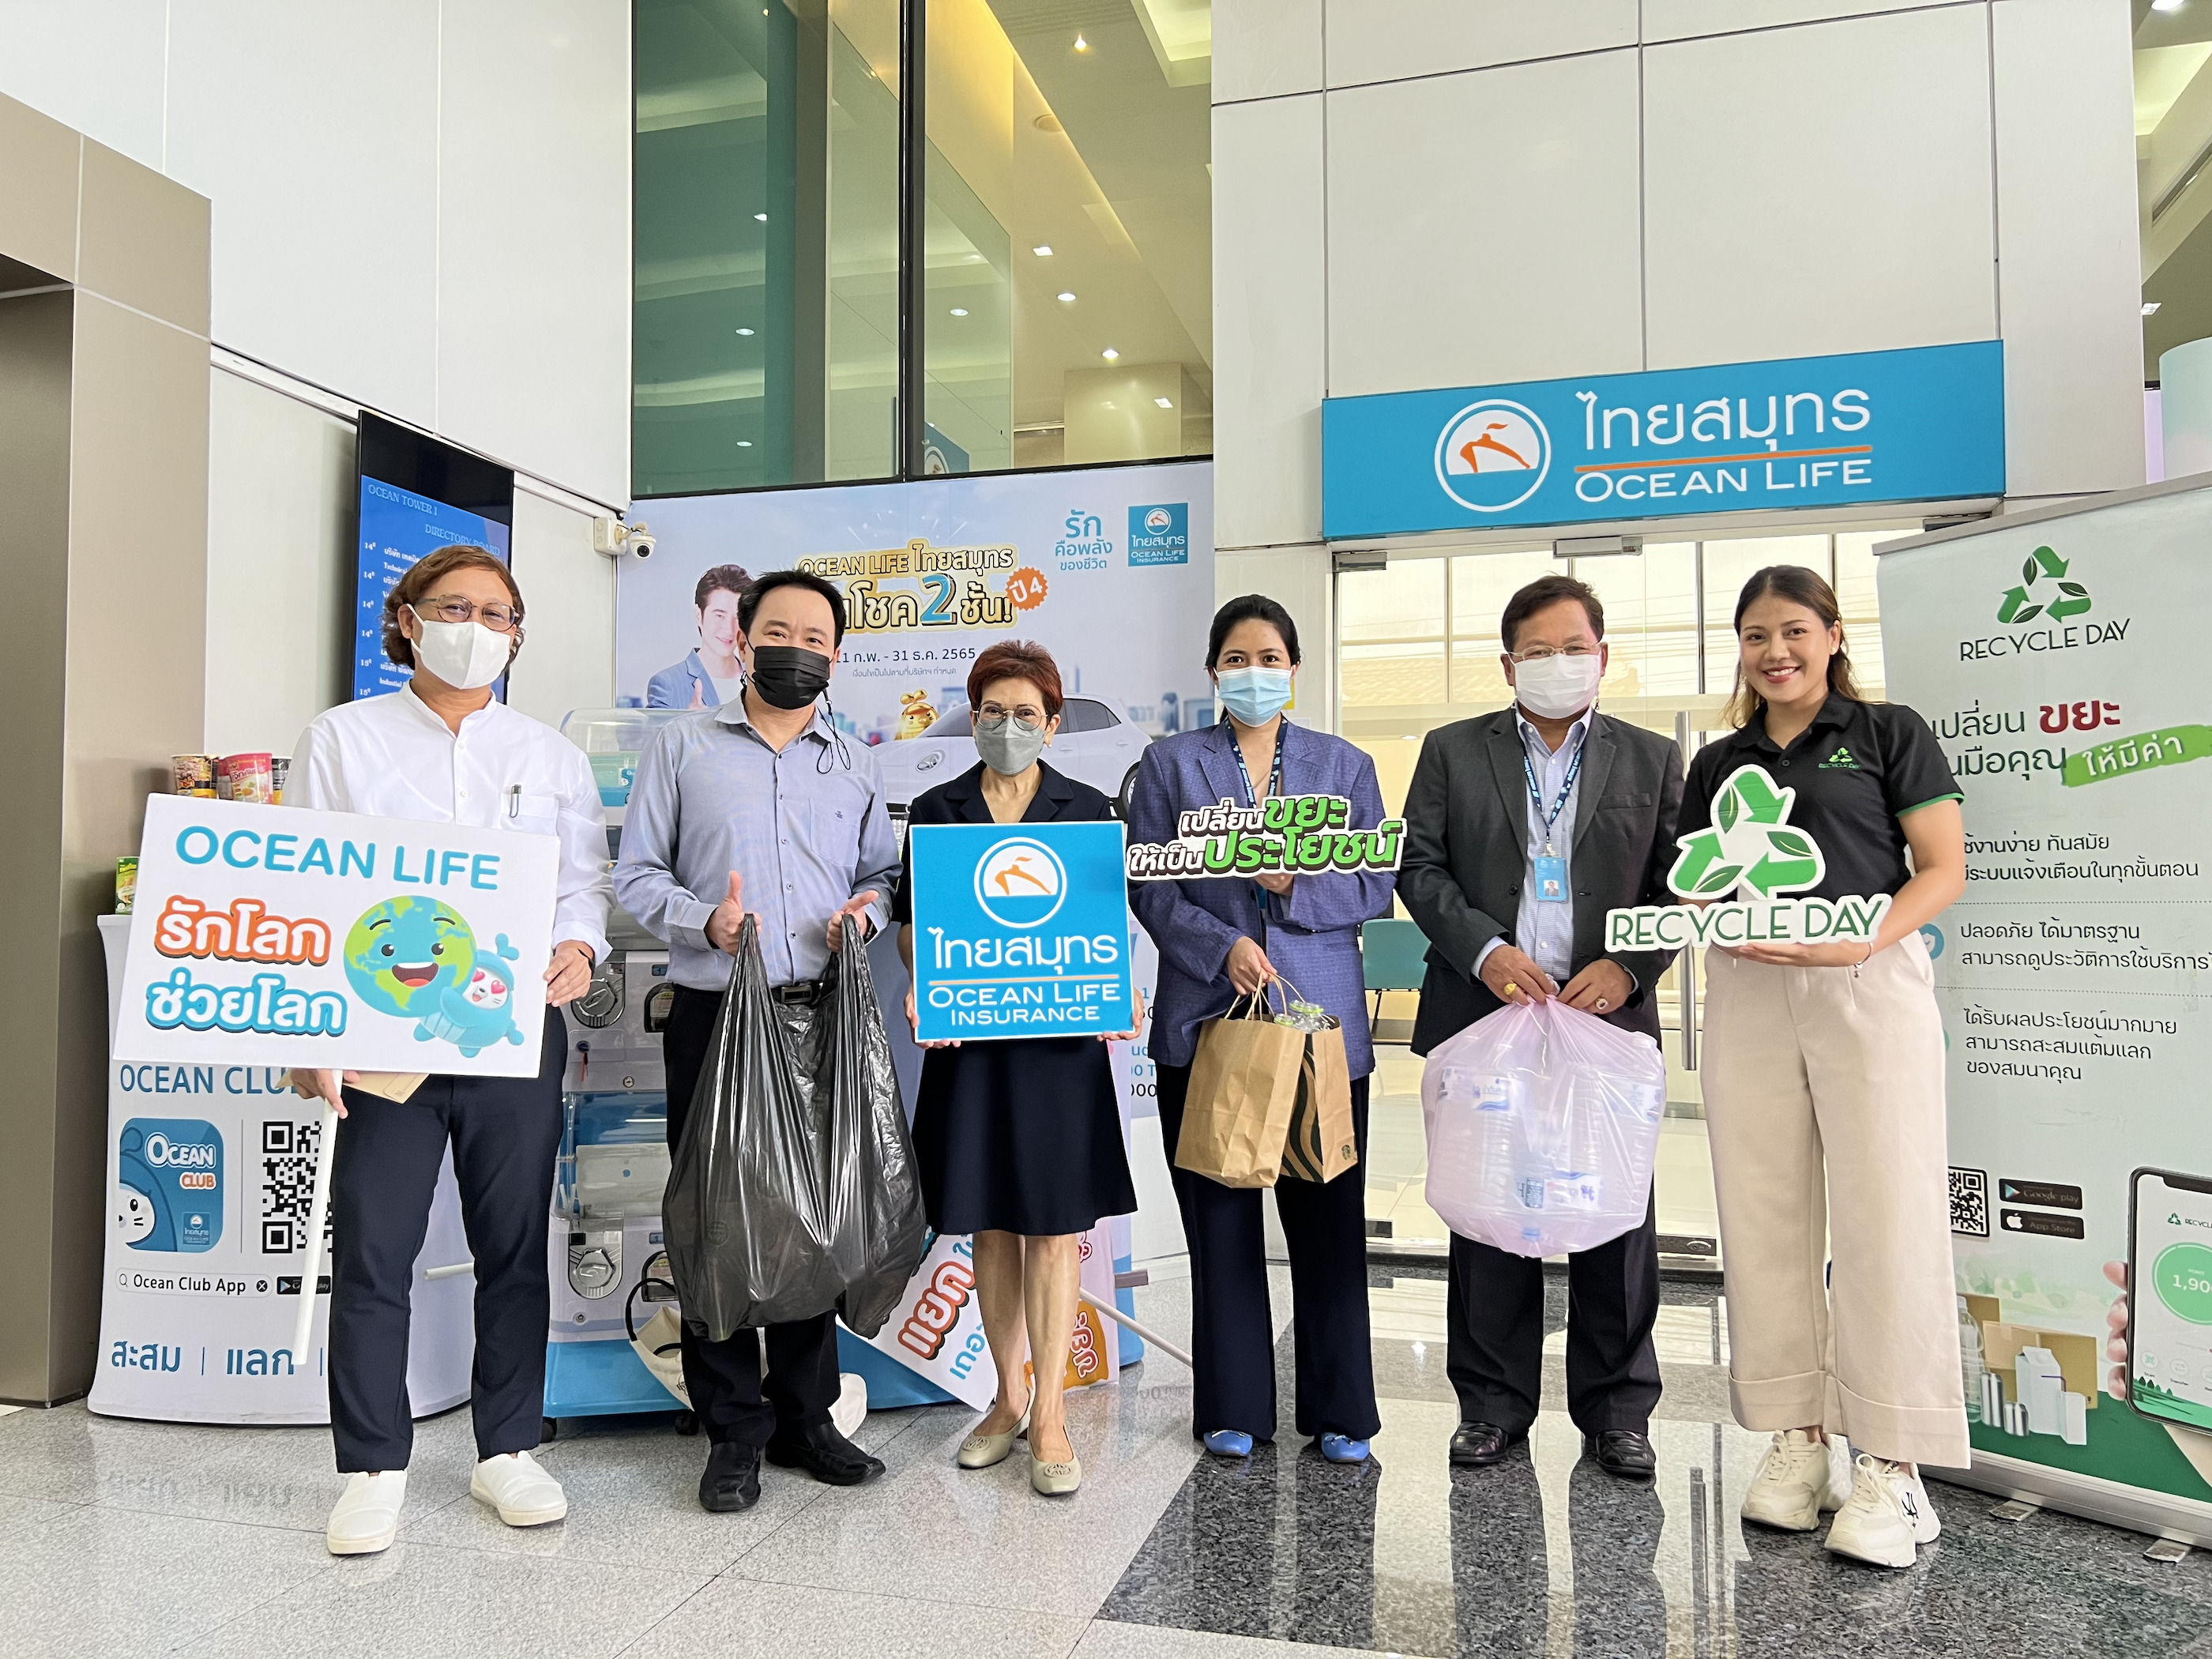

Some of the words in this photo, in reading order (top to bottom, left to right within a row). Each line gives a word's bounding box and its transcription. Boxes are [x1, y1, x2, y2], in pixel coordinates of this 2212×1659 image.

[1574, 387, 1872, 453] ไทยสมุทร
[1575, 468, 1748, 503] OCEAN
[1765, 459, 1872, 491] LIFE
[368, 484, 399, 503] OCEAN
[402, 495, 433, 514] TOWER
[425, 524, 472, 545] DIRECTORY
[1065, 510, 1101, 539] รัก
[1055, 538, 1113, 557] คือพลัง
[1131, 535, 1185, 549] ไทยสมุทร
[799, 555, 865, 577] OCEAN
[869, 553, 909, 574] LIFE
[912, 544, 1014, 577] ไทยสมุทร
[1059, 557, 1107, 571] ของชีวิต
[961, 581, 1014, 624] ชั้น!
[1009, 581, 1027, 604] ปี
[1029, 578, 1043, 596] 4
[1959, 626, 2078, 661] RECYCLE
[2086, 619, 2131, 645] DAY
[854, 653, 881, 663] ก.พ.
[893, 650, 908, 661] 31
[912, 649, 938, 660] ธ.ค.
[942, 648, 976, 660] 2565
[1932, 699, 2026, 739] เปลี่ยน
[2039, 700, 2120, 734] ขยะ
[2082, 733, 2184, 777] ให้มีค่า
[1964, 830, 2041, 854] ช้งานง่าย
[2047, 833, 2109, 852] ทันสมัย
[175, 825, 377, 880] OCEAN
[393, 845, 501, 890] LIFE
[156, 895, 331, 963] รักโลก
[1612, 905, 1791, 946] RECYCLE
[1804, 901, 1883, 938] DAY
[1960, 921, 2033, 939] ปลอดภัย
[2039, 916, 2140, 943] ได้มาตรฐาน
[927, 926, 1119, 975] ไทยสมุทร
[1962, 946, 2212, 971] สามารถดูประวัติการใช้บริการ
[147, 967, 348, 1036] ช่วยโลก
[928, 986, 1043, 1008] OCEAN
[1054, 983, 1121, 1003] LIFE
[951, 1006, 1100, 1026] INSURANCE
[1963, 1003, 2177, 1035] ได้รับผลประโยชน์มากมาย
[1966, 1033, 2152, 1060] สามารถสะสมแต้มแลก
[120, 1063, 214, 1094] OCEAN
[224, 1066, 297, 1094] CLU
[1966, 1060, 2082, 1084] ของสมนาคุณ
[146, 1133, 216, 1168] OCEAN
[181, 1173, 216, 1189] CLUB
[2023, 1189, 2056, 1202] Google
[2060, 1194, 2079, 1204] play
[2030, 1221, 2049, 1231] App
[2051, 1224, 2075, 1233] Store
[133, 1273, 175, 1291] Ocean
[179, 1276, 211, 1293] Club
[216, 1278, 246, 1296] App
[2172, 1274, 2212, 1294] 1,90
[899, 1262, 974, 1359] แยก
[111, 1341, 182, 1372] สะสม
[226, 1348, 295, 1376] แลก
